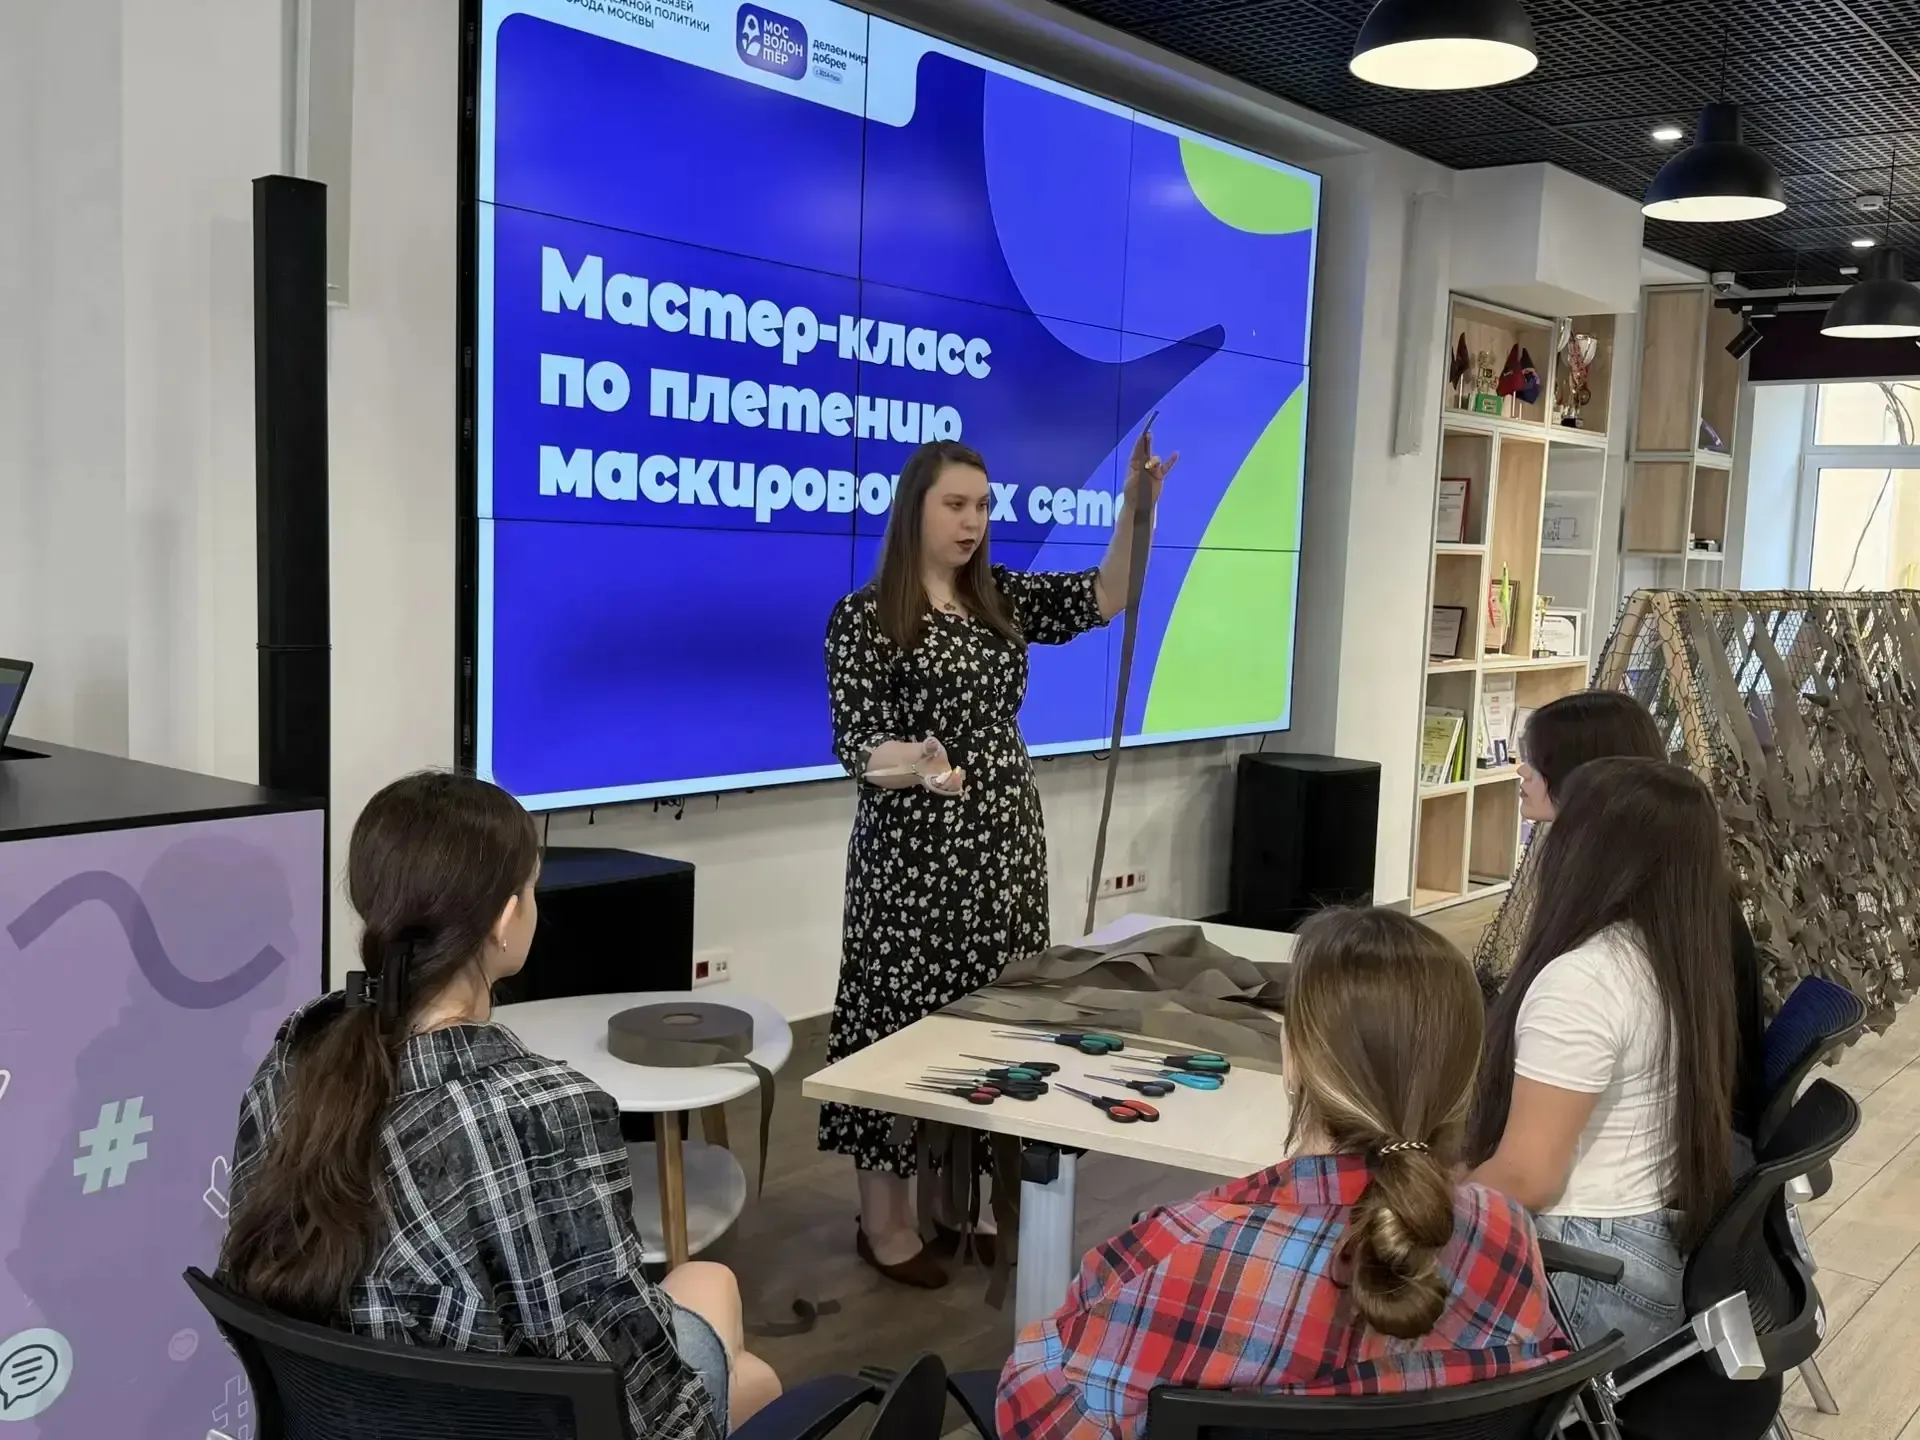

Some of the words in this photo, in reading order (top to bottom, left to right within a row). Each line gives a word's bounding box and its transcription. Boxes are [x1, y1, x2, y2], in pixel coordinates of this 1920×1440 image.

[607, 5, 654, 29] МОСКВЫ
[654, 6, 710, 33] ПОЛИТИКИ
[763, 20, 789, 39] МОС
[763, 33, 803, 57] ВОЛОН
[813, 39, 847, 57] делаем
[849, 52, 868, 66] мир
[812, 52, 847, 71] добрее
[541, 246, 991, 378] Мастер-класс
[540, 353, 630, 412] по
[650, 368, 962, 445] плетению
[1028, 485, 1158, 532] сет
